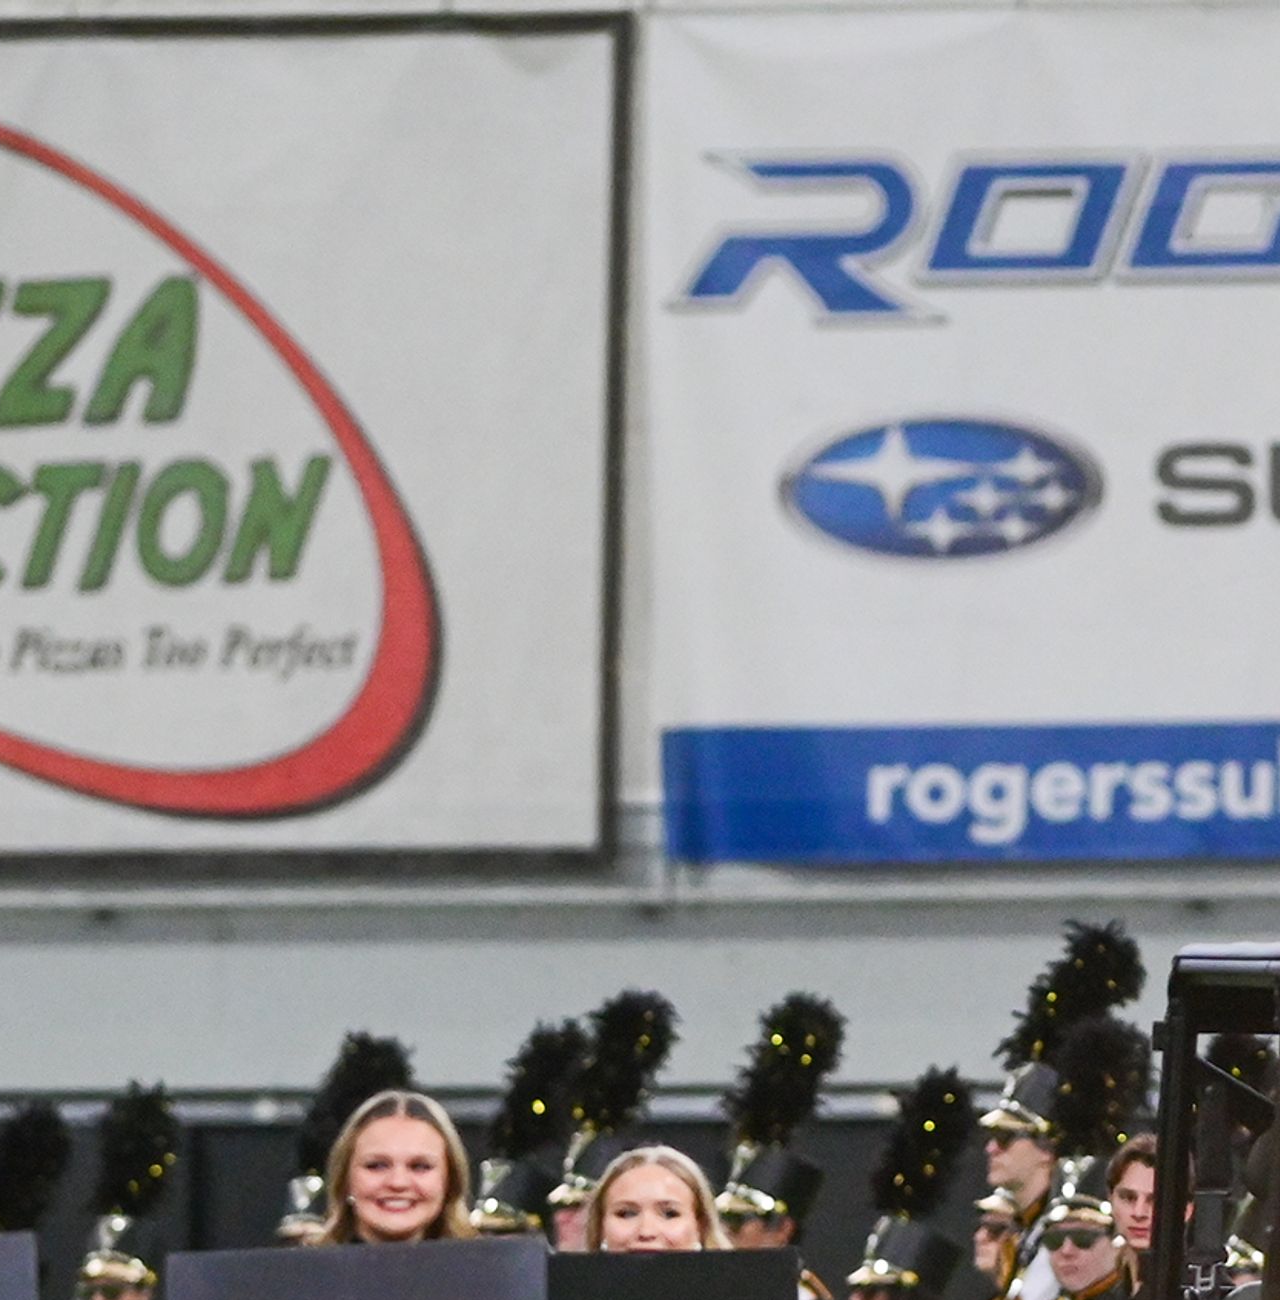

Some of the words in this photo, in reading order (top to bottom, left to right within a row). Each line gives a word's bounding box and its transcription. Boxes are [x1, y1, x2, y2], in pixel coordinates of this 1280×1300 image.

[9, 625, 126, 675] Pizzas
[140, 622, 209, 670] Too
[220, 621, 357, 683] Perfect
